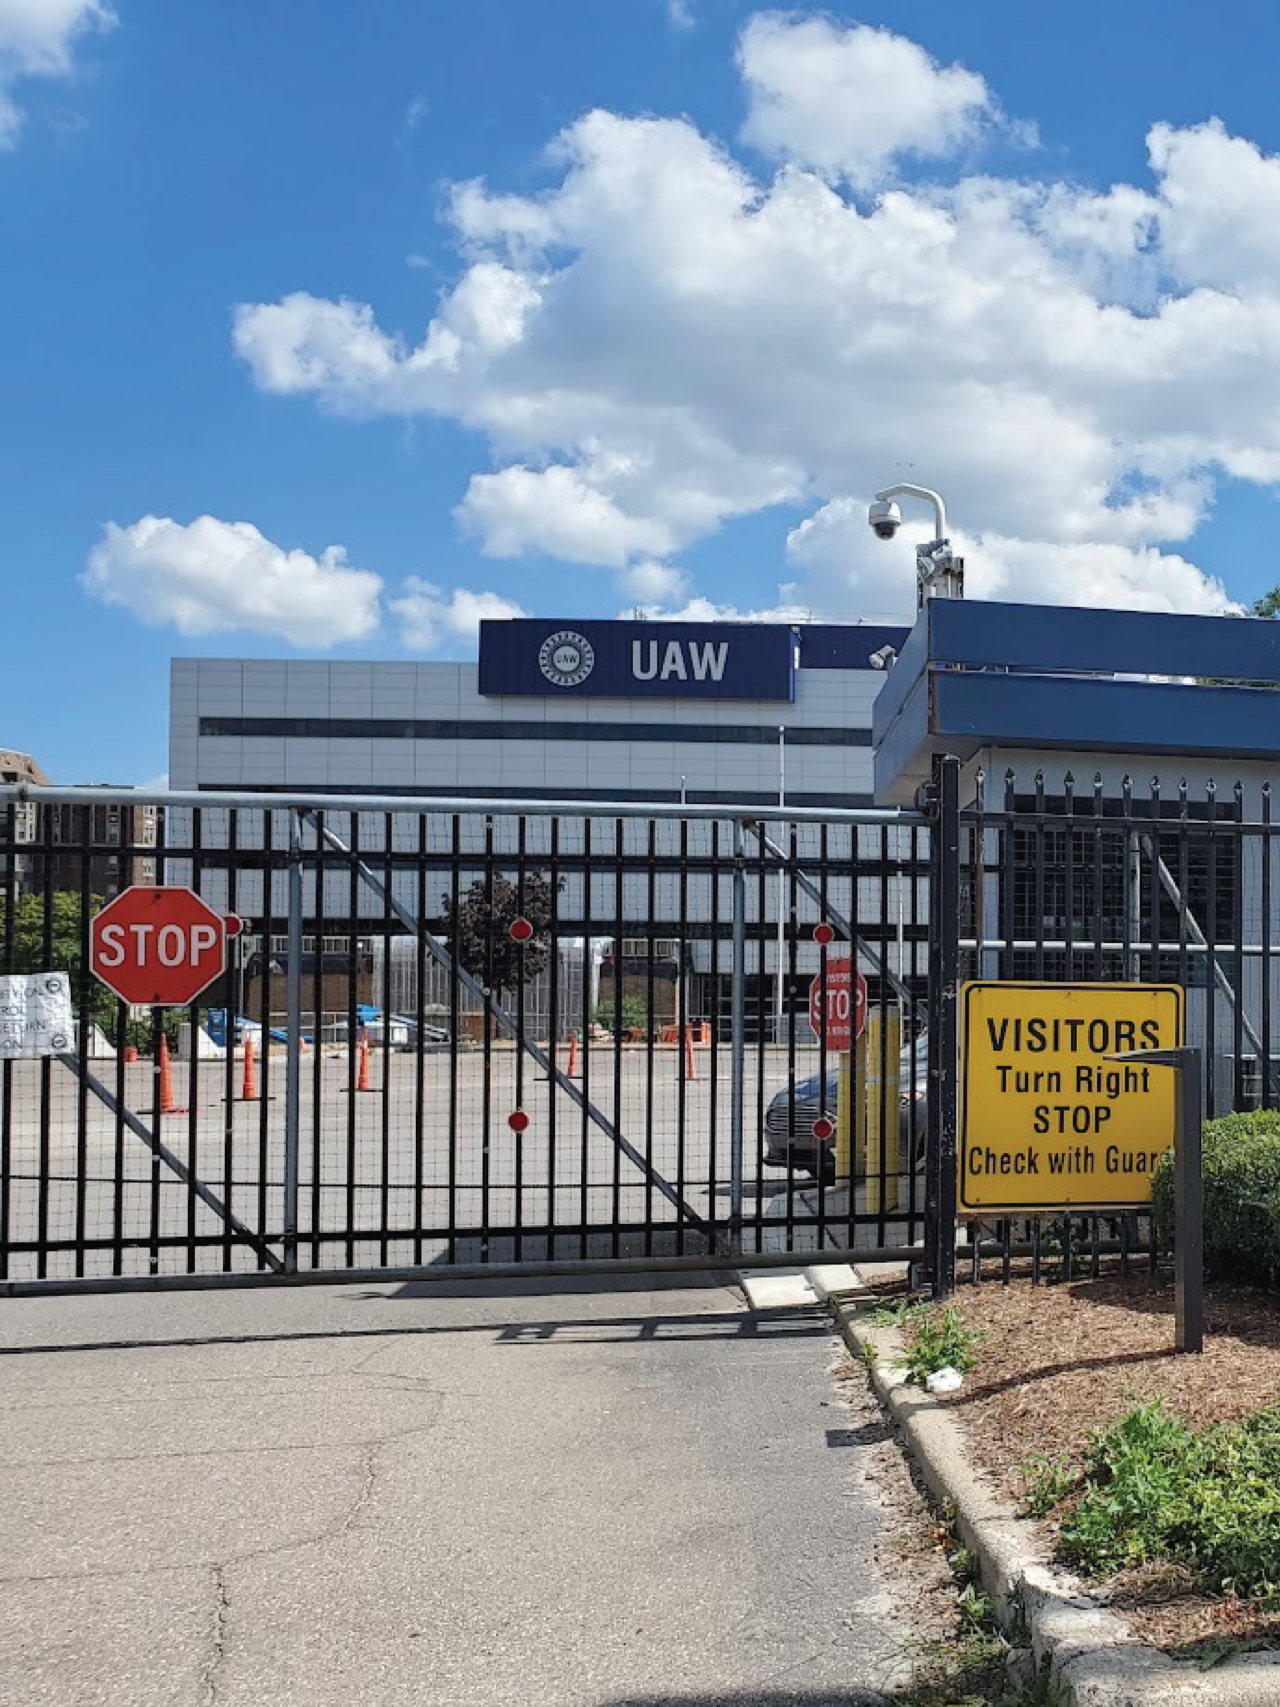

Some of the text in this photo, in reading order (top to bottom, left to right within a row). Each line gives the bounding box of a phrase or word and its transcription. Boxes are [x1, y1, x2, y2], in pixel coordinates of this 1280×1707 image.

[632, 640, 729, 681] UAW
[99, 924, 217, 967] STOP
[987, 1018, 1160, 1053] VISITORS
[996, 1065, 1150, 1099] Turn Right
[1033, 1105, 1111, 1134] STOP
[968, 1145, 1165, 1175] Check with Guar
